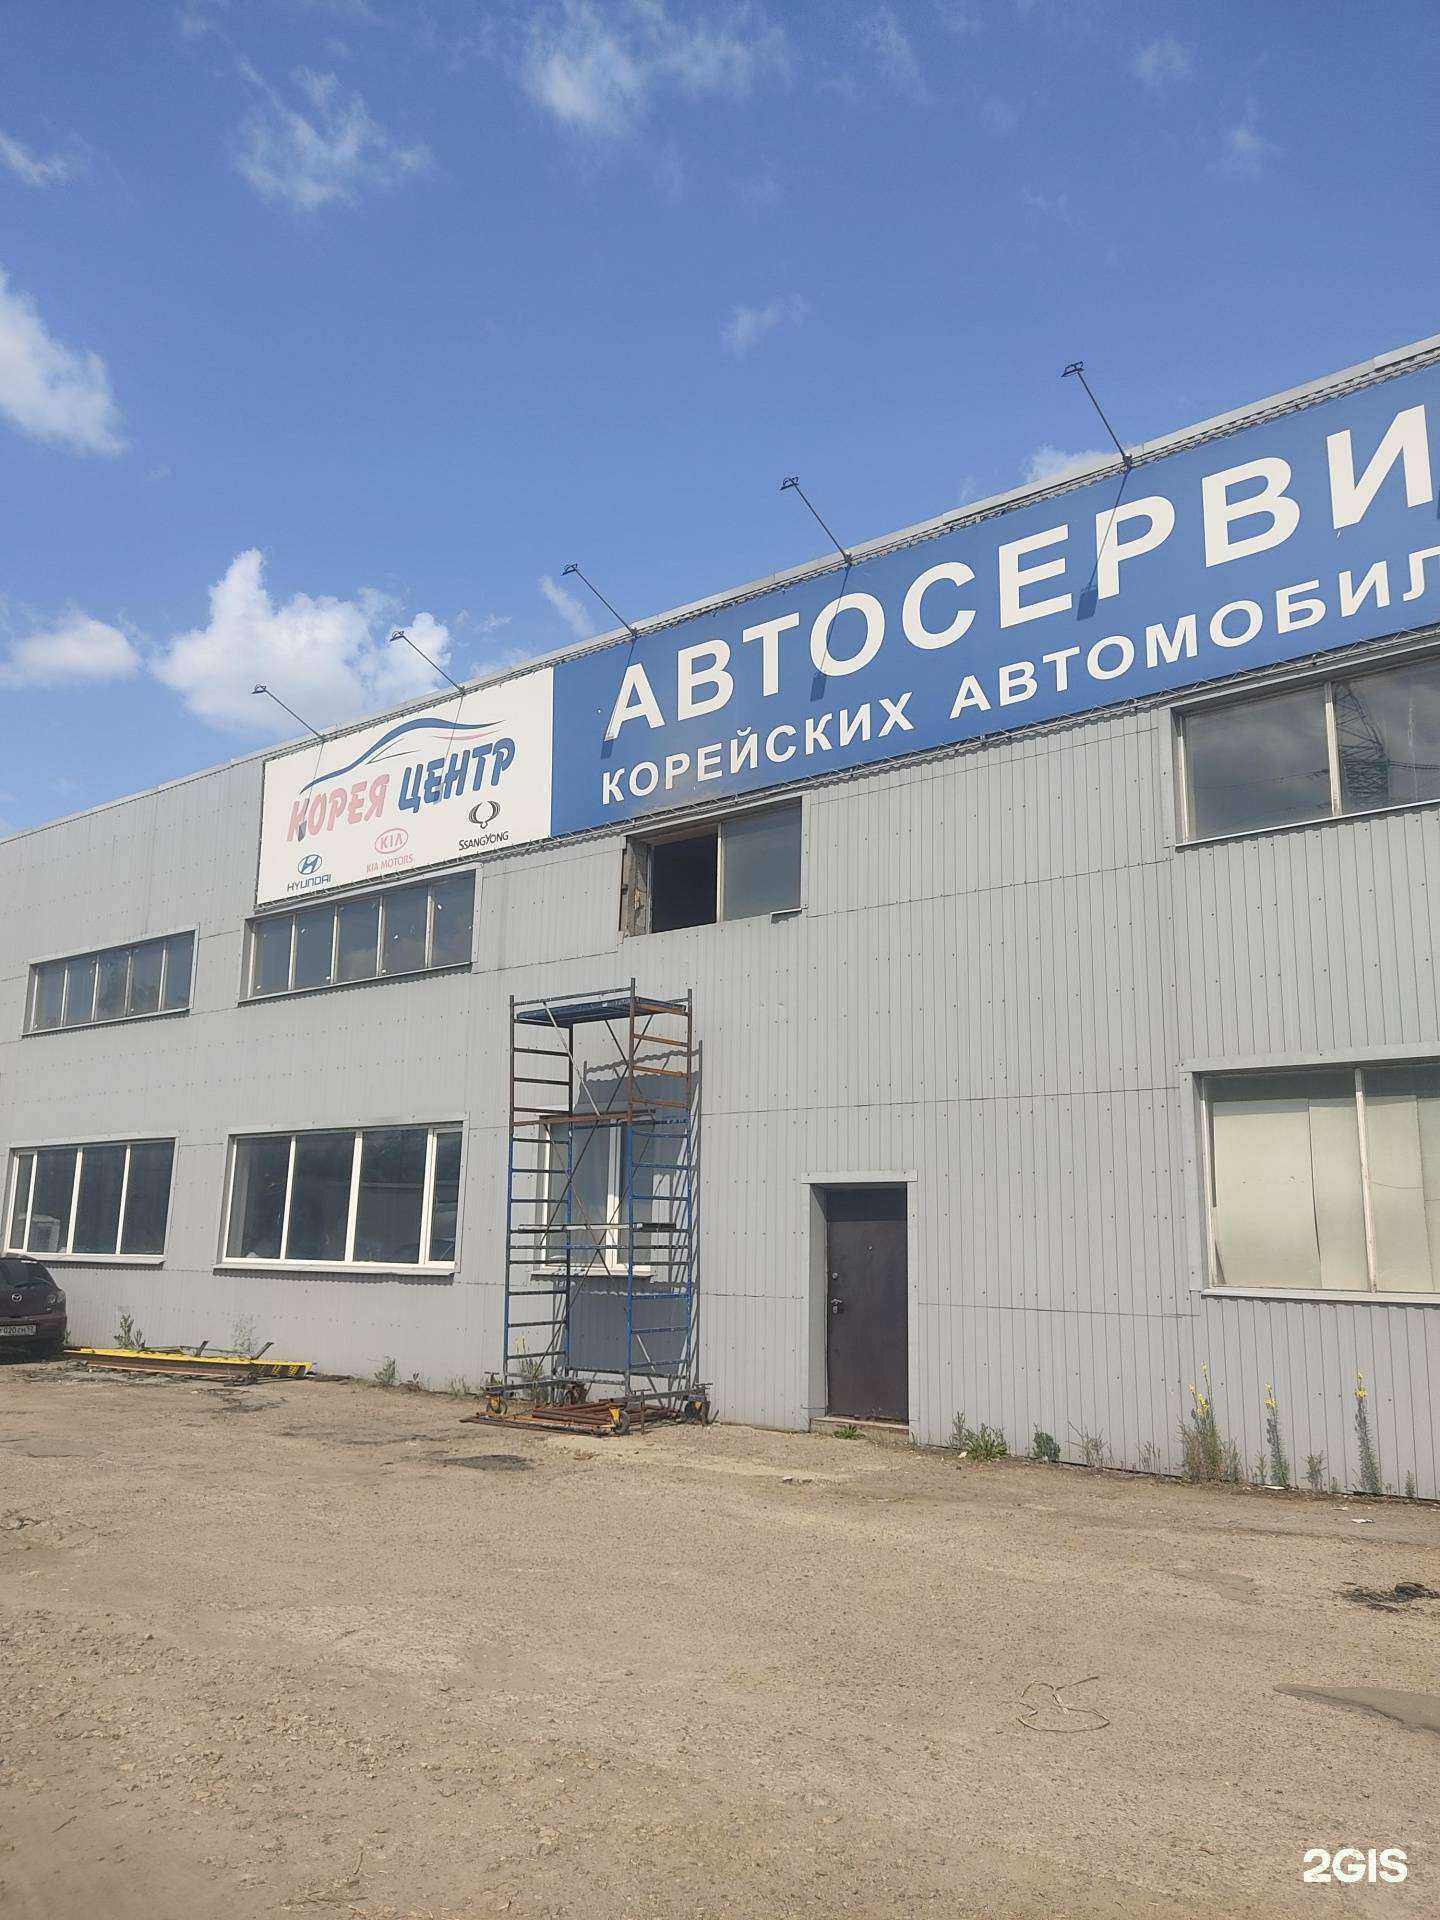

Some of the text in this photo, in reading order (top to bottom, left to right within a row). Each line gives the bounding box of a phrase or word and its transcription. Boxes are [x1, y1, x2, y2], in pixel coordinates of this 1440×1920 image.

[603, 403, 1434, 742] АВТОСЕРВИ
[602, 691, 915, 805] КОРЕЙСКИХ
[286, 736, 516, 842] КОРЕЯ ЦЕНТР
[366, 853, 414, 874] KIA MOTORS
[379, 832, 403, 850] KIA
[286, 873, 332, 893] HYUNDAI
